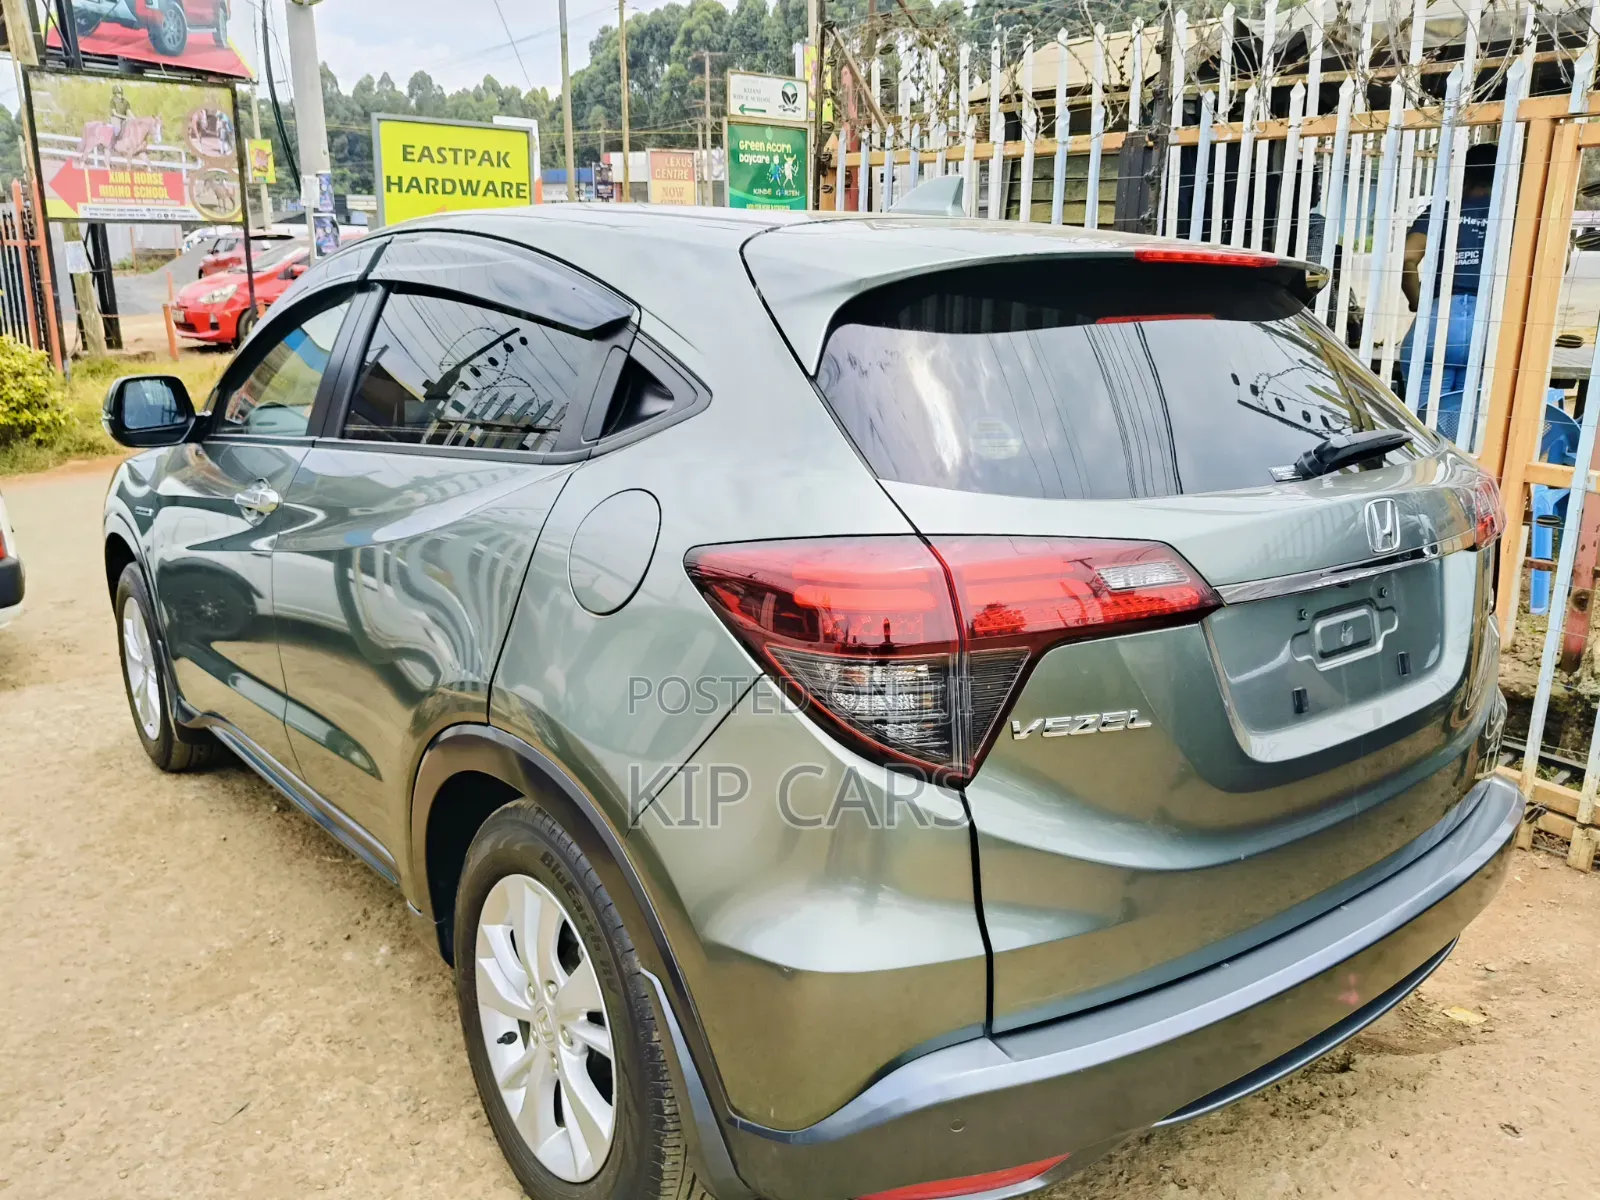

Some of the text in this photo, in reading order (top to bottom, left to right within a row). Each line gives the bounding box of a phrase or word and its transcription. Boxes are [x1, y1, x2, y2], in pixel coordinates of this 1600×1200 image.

[739, 140, 792, 154] Green Acorn
[402, 144, 511, 168] EASTPAK
[739, 153, 770, 166] Daycare
[655, 169, 689, 180] CENTRE
[133, 185, 170, 199] SCHOOL
[386, 175, 527, 199] HARDWARE
[661, 186, 684, 198] NOW
[1011, 709, 1153, 741] VEZEL
